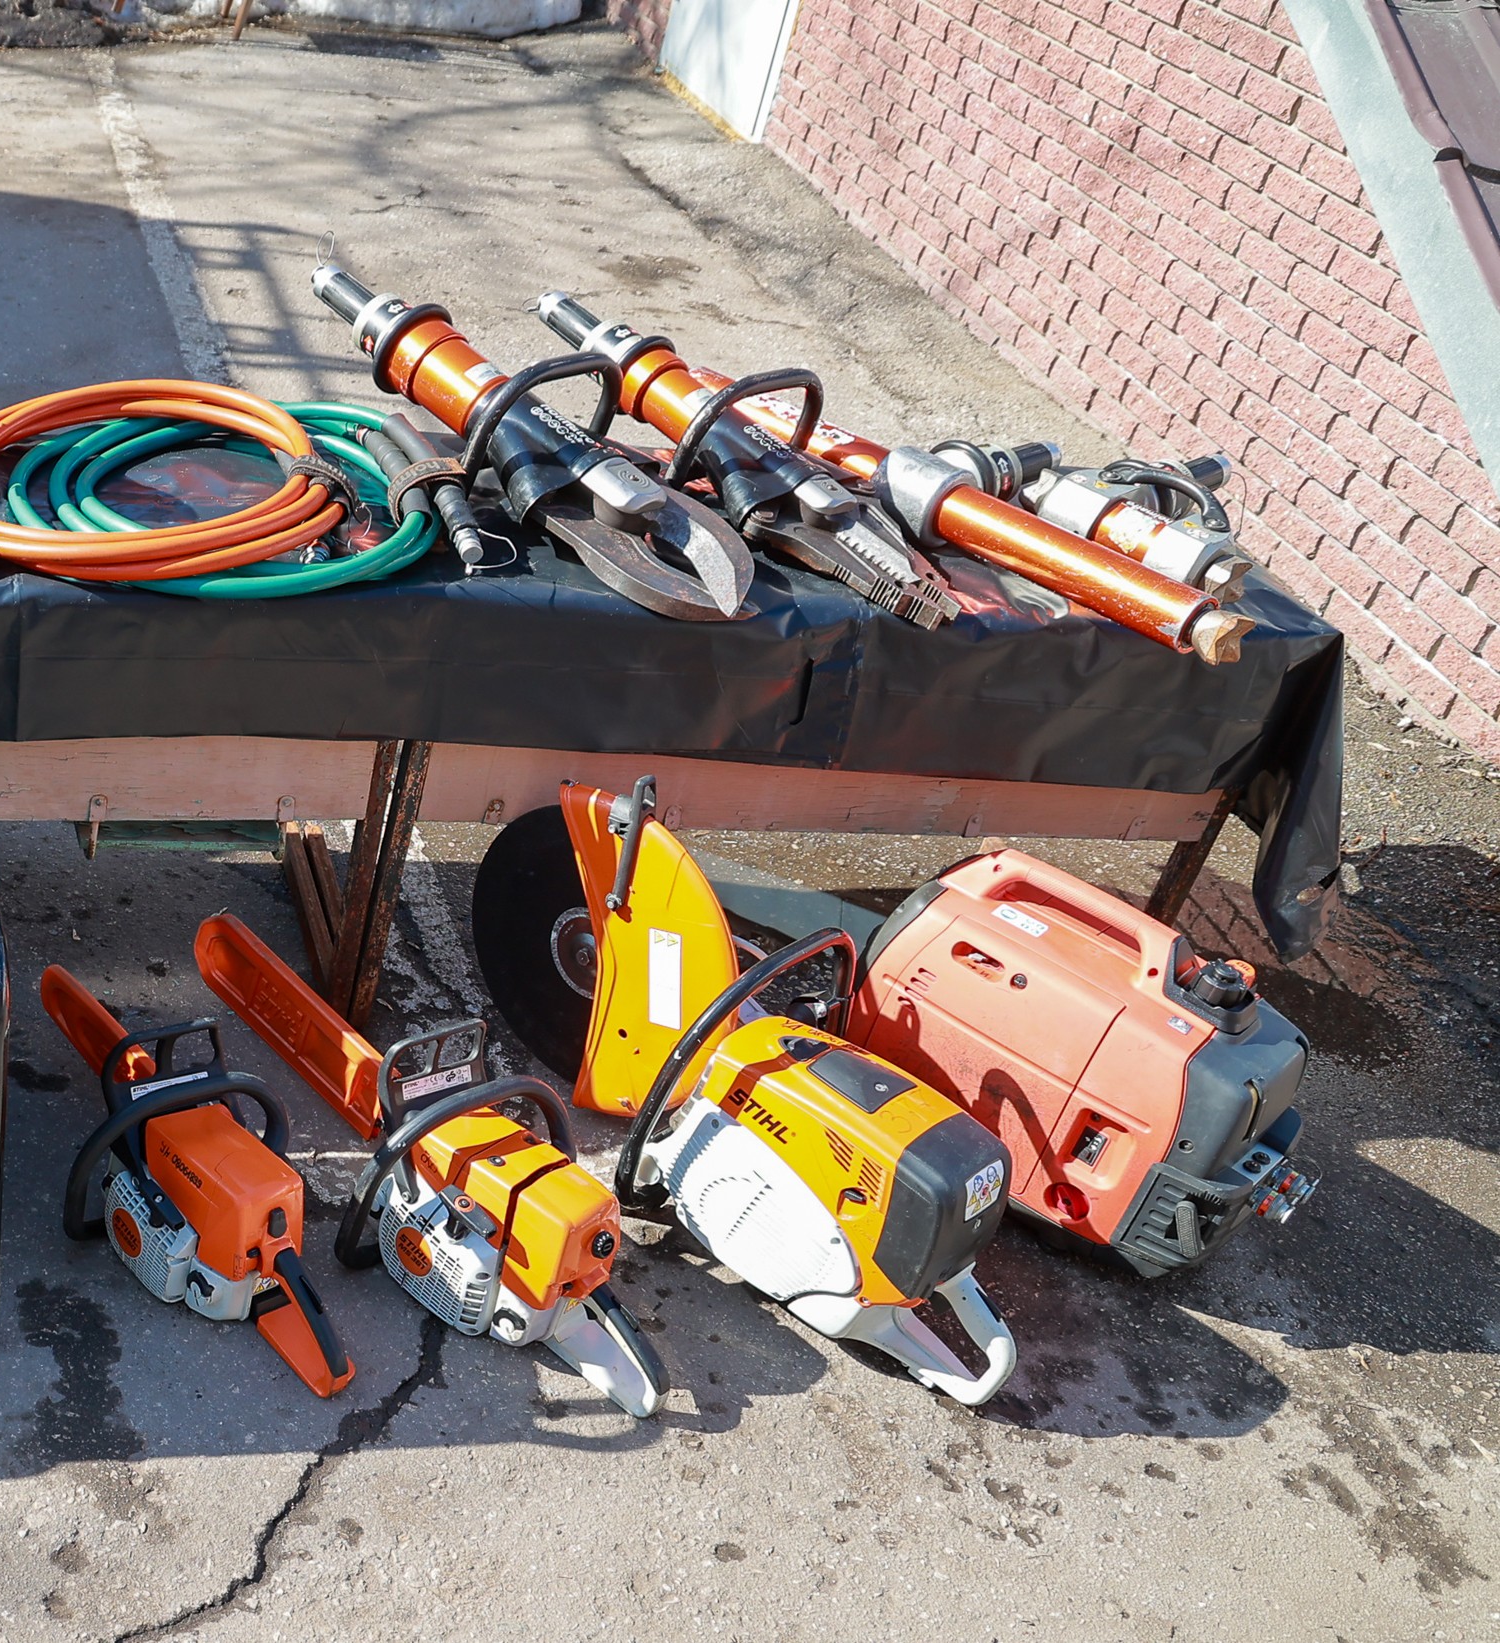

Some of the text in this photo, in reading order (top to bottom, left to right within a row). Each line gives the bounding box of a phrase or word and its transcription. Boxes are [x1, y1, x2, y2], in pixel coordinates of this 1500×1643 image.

[728, 1088, 789, 1145] STIHL
[115, 1215, 138, 1248] STIHL
[399, 1233, 428, 1267] STIHL
